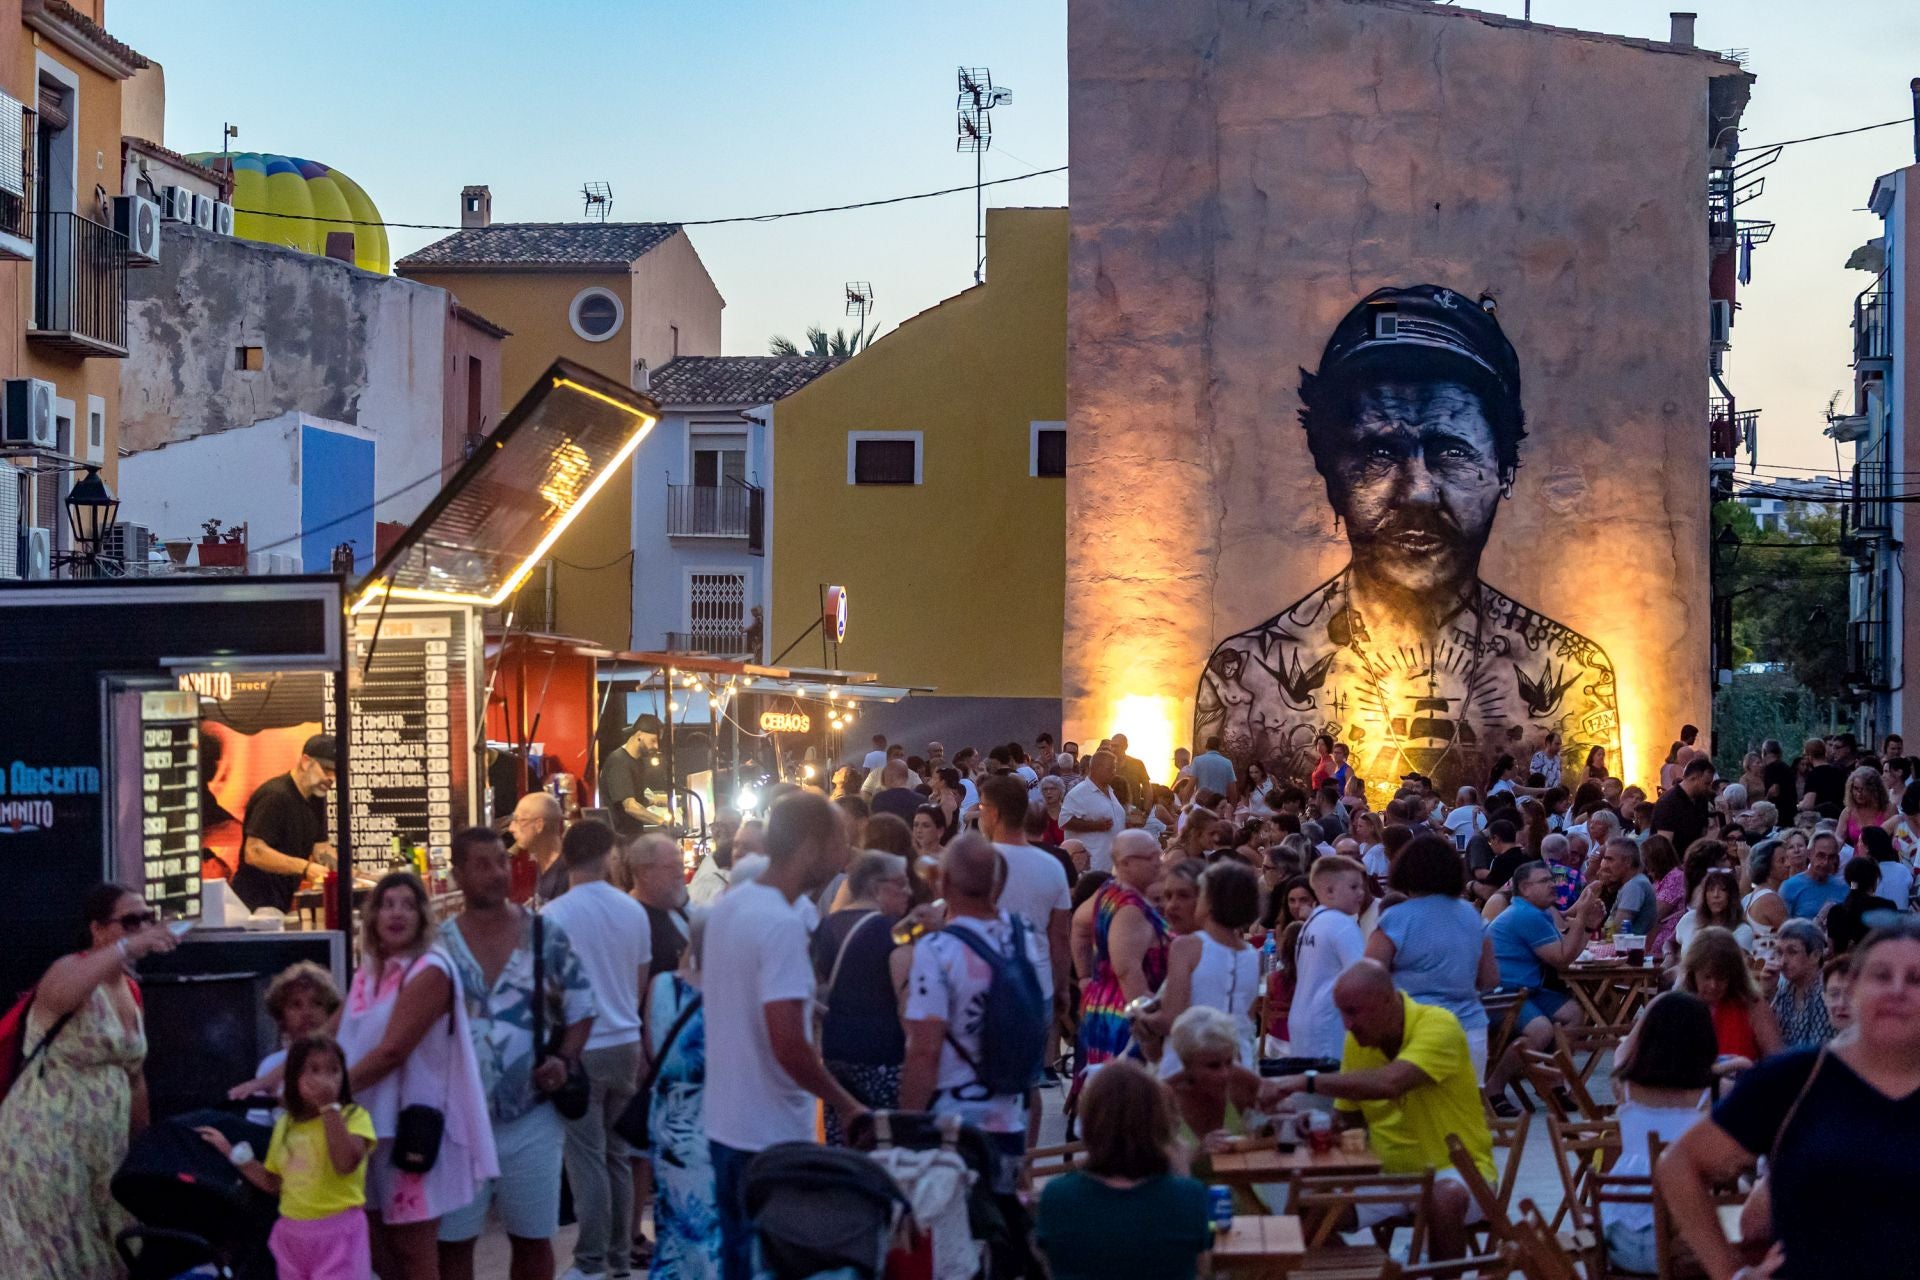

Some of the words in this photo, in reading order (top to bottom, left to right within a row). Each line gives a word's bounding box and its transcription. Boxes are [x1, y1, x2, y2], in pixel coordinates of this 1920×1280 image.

[179, 672, 232, 700] MINITO
[236, 682, 267, 690] TRUCK
[0, 800, 53, 828] MINITO
